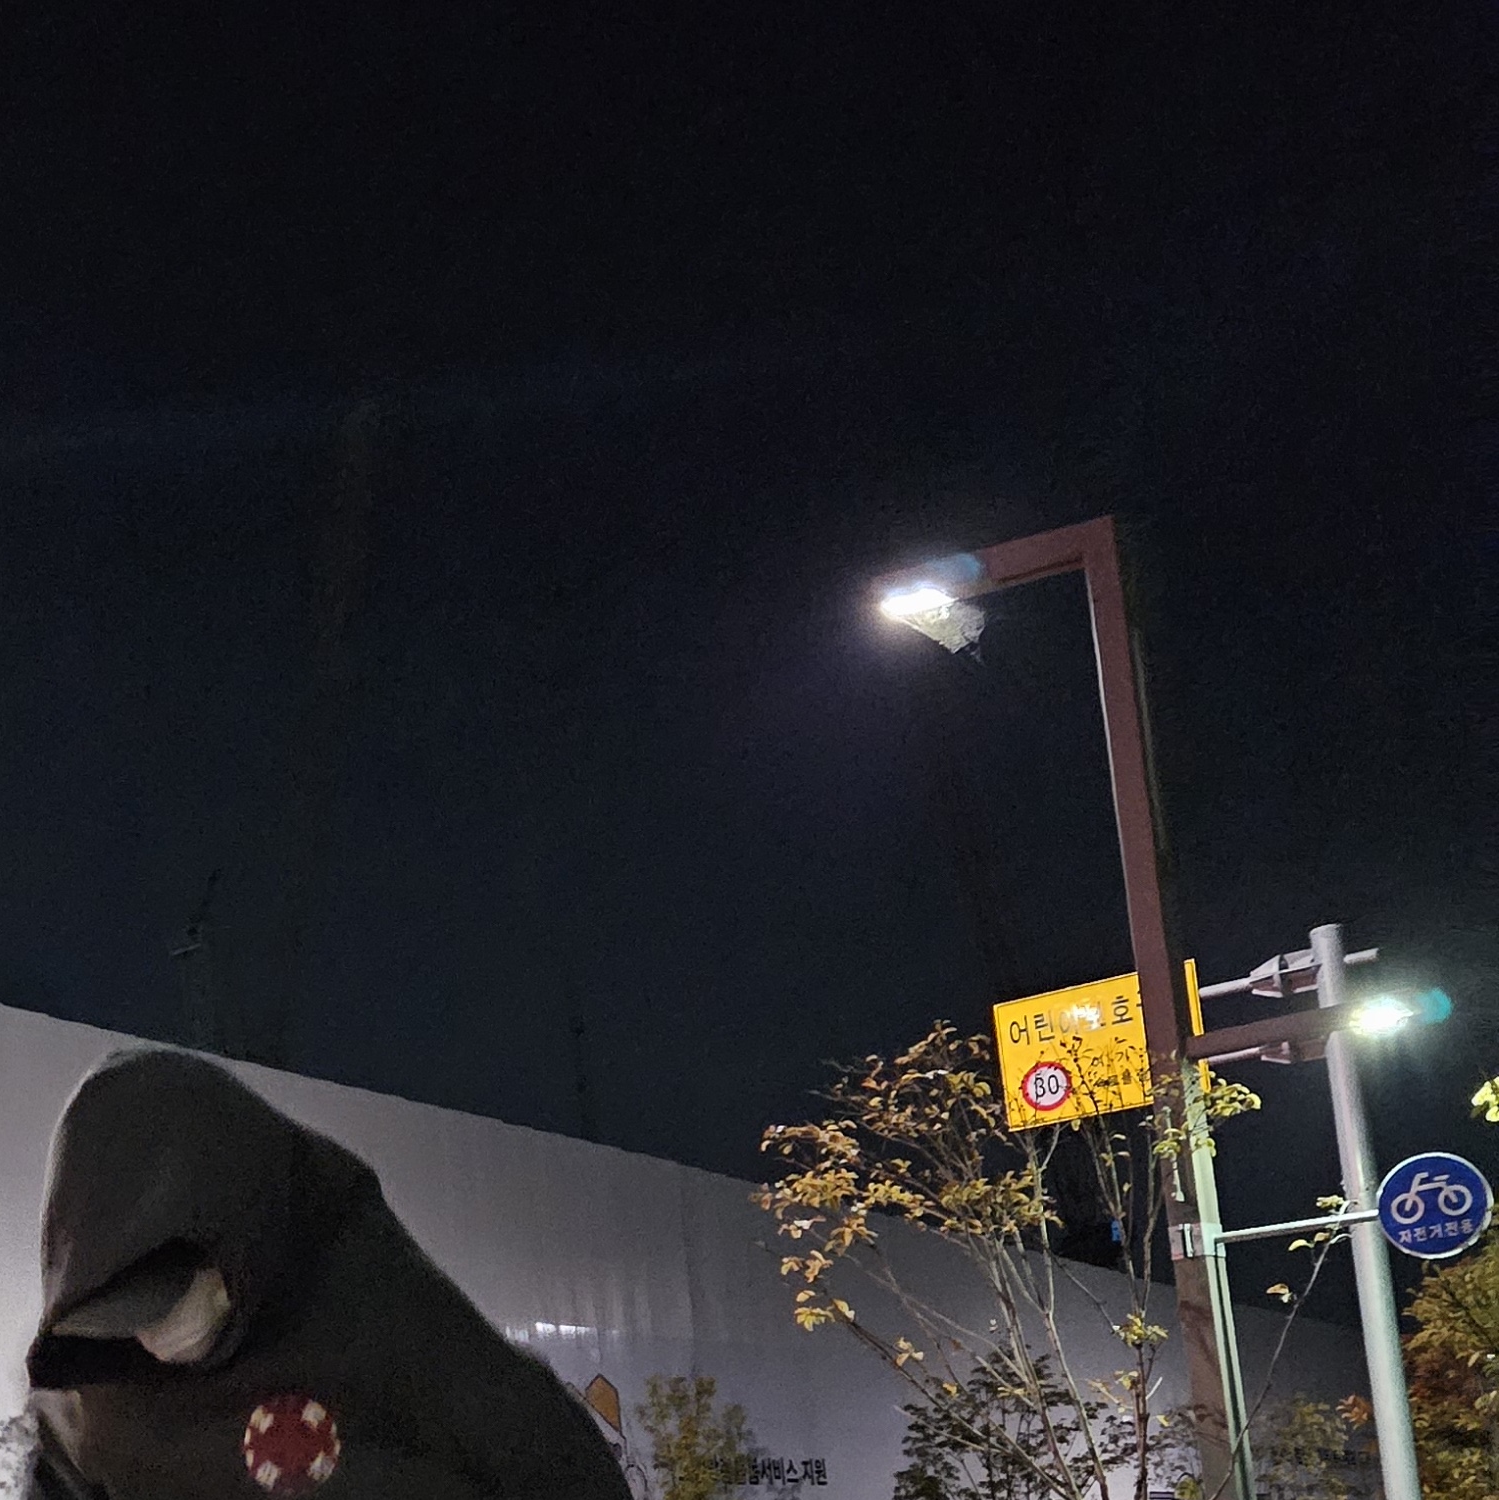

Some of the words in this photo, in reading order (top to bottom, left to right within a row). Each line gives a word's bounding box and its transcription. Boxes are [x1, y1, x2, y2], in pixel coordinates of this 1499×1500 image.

[1033, 1073, 1061, 1099] 30
[1398, 1218, 1474, 1244] 자전거전용
[801, 1457, 828, 1486] 지원
